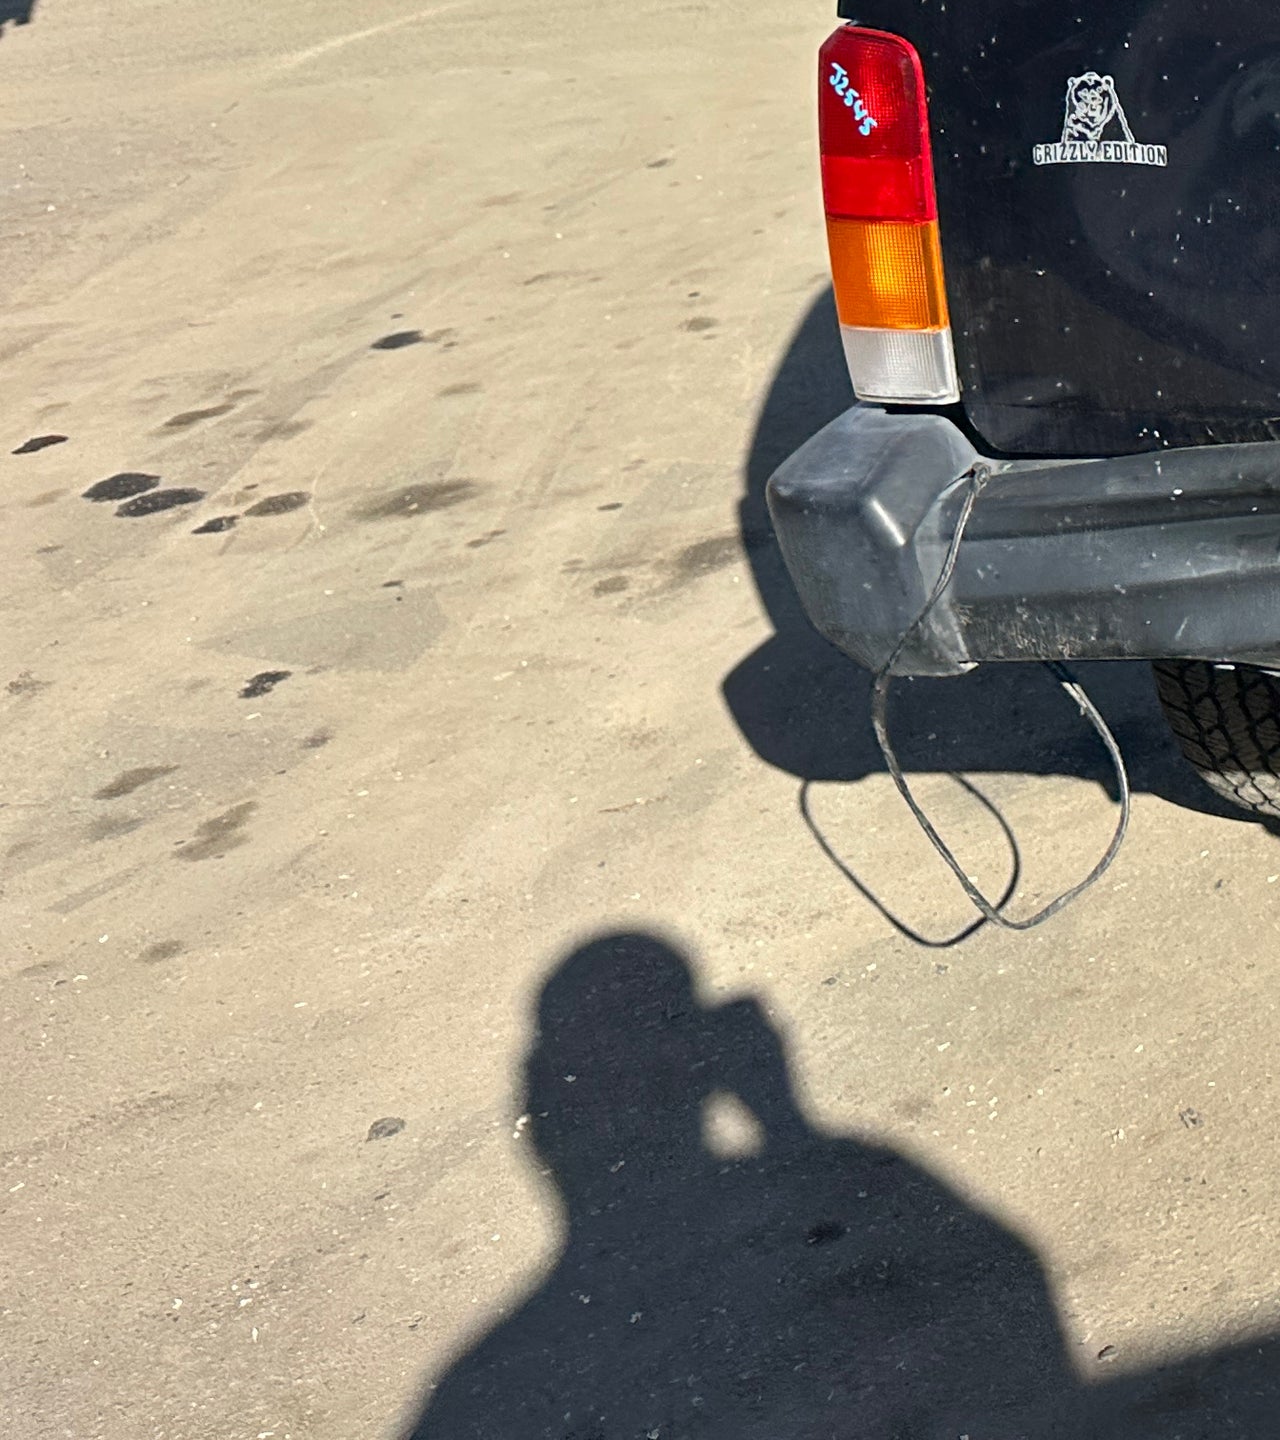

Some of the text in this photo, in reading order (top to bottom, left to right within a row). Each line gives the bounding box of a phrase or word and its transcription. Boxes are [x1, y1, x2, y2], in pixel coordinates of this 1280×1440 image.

[829, 62, 878, 136] J2545
[1033, 143, 1167, 167] GRIZZLY EDITION
